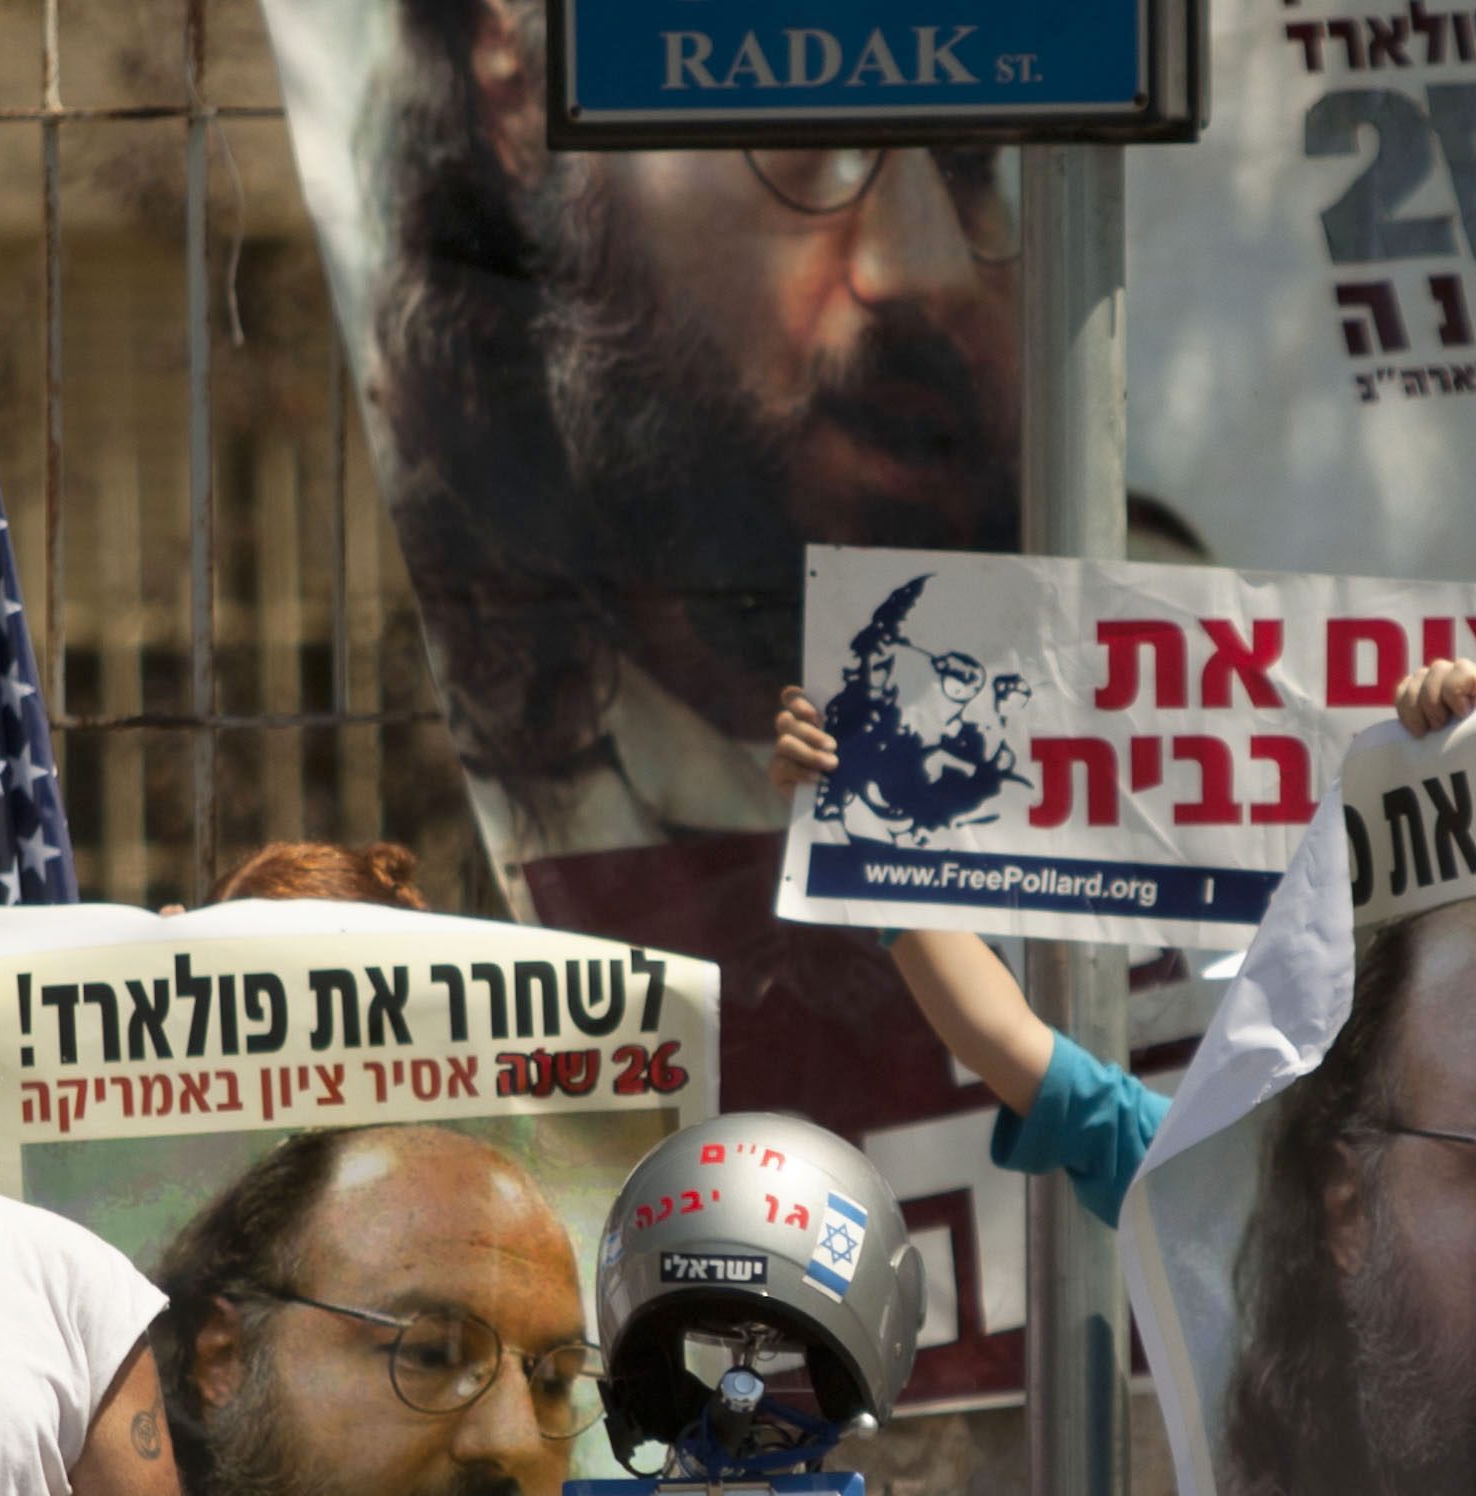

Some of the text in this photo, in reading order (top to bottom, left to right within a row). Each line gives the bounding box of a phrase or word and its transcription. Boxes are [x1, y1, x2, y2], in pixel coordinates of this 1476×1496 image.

[660, 24, 1042, 91] RADAK ST.
[1094, 618, 1284, 710] את
[1028, 733, 1320, 829] בבית
[865, 857, 1158, 907] www.FreePollard.org
[16, 947, 665, 1067] לשחרר את פולארד!
[21, 1041, 688, 1133] 26 שנה אסיר ציון באמריקה
[700, 1143, 786, 1171] חיים
[664, 1255, 763, 1281] ישראלי
